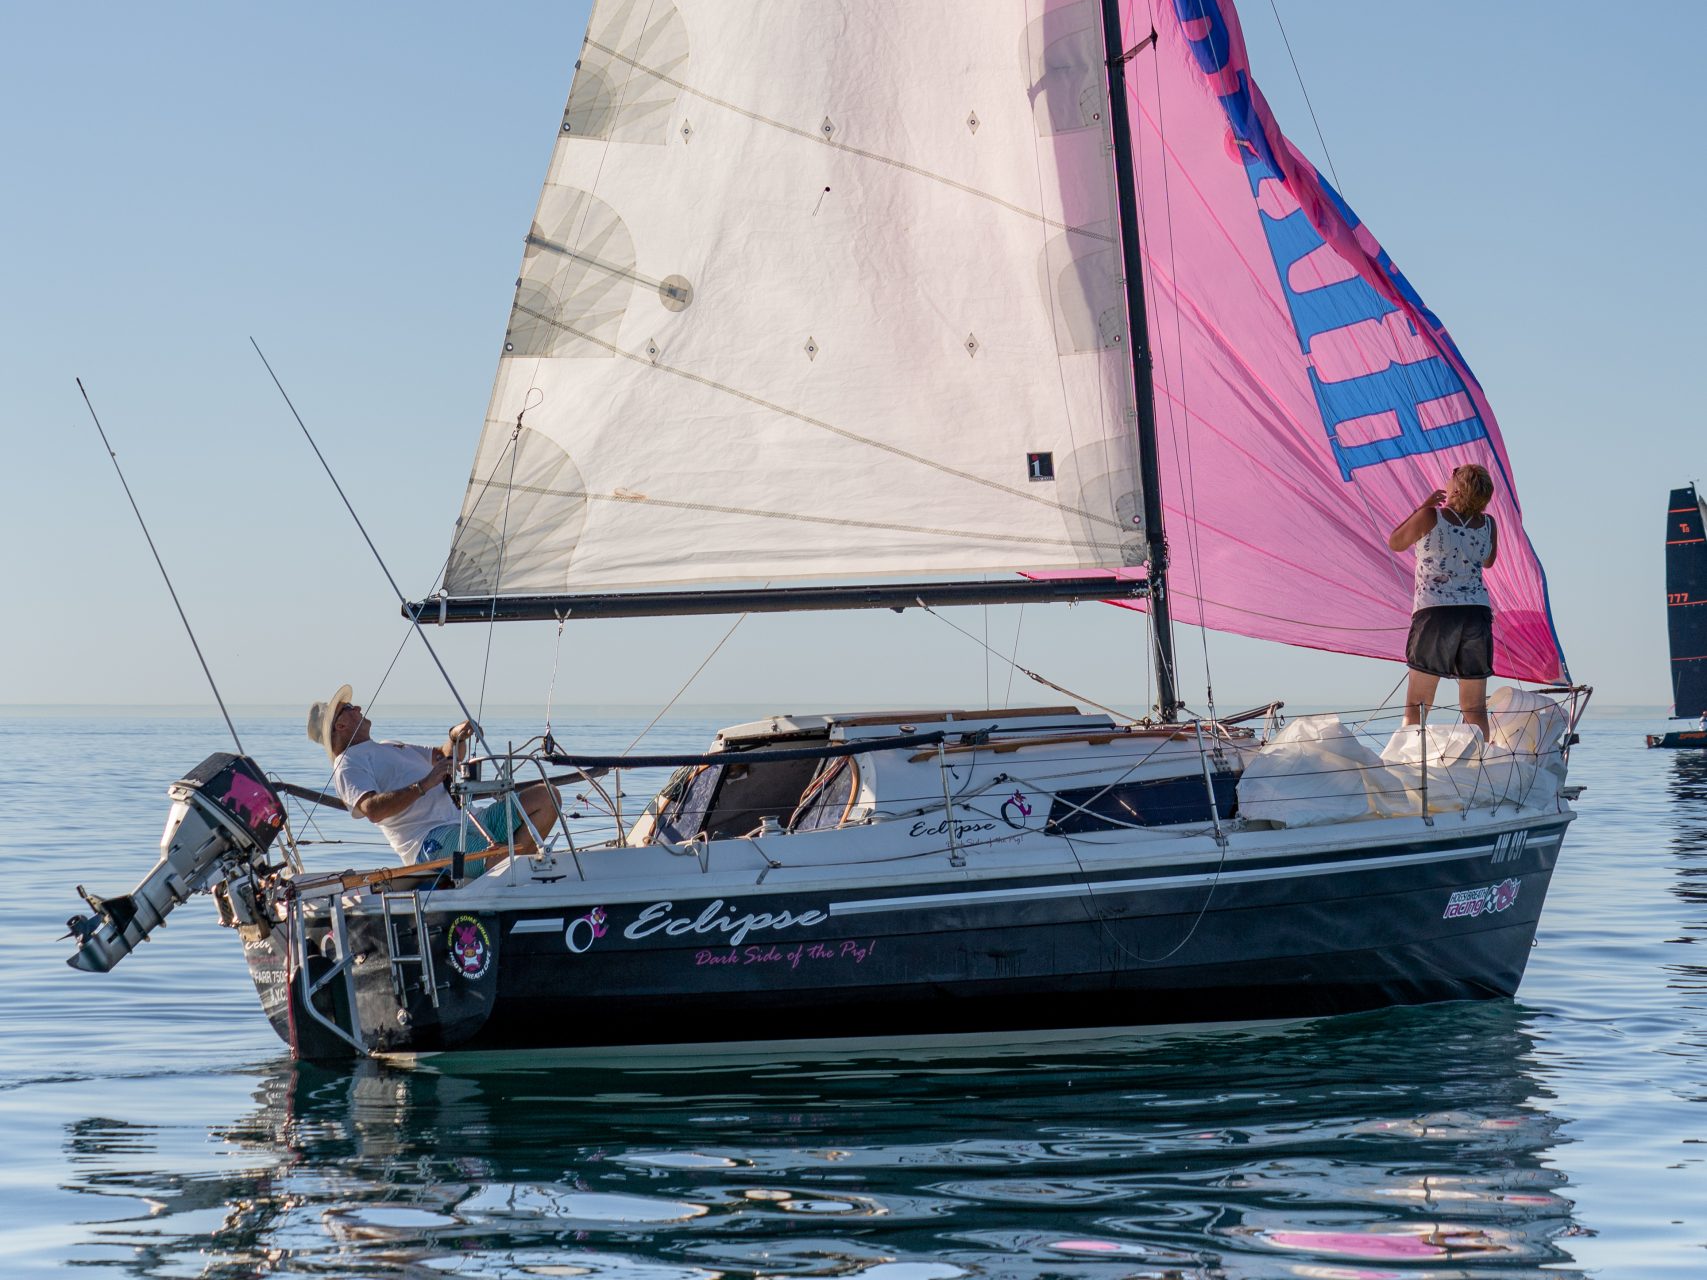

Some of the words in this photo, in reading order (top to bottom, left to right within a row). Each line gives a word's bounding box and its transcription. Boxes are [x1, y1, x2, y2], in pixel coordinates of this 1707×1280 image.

[1667, 592, 1689, 604] 777
[909, 819, 997, 839] Eclpse
[624, 899, 828, 946] Eclipse
[695, 948, 739, 965] Dark
[743, 945, 783, 965] Side
[786, 944, 802, 968] of
[807, 943, 835, 959] the
[840, 939, 876, 964] Pig!
